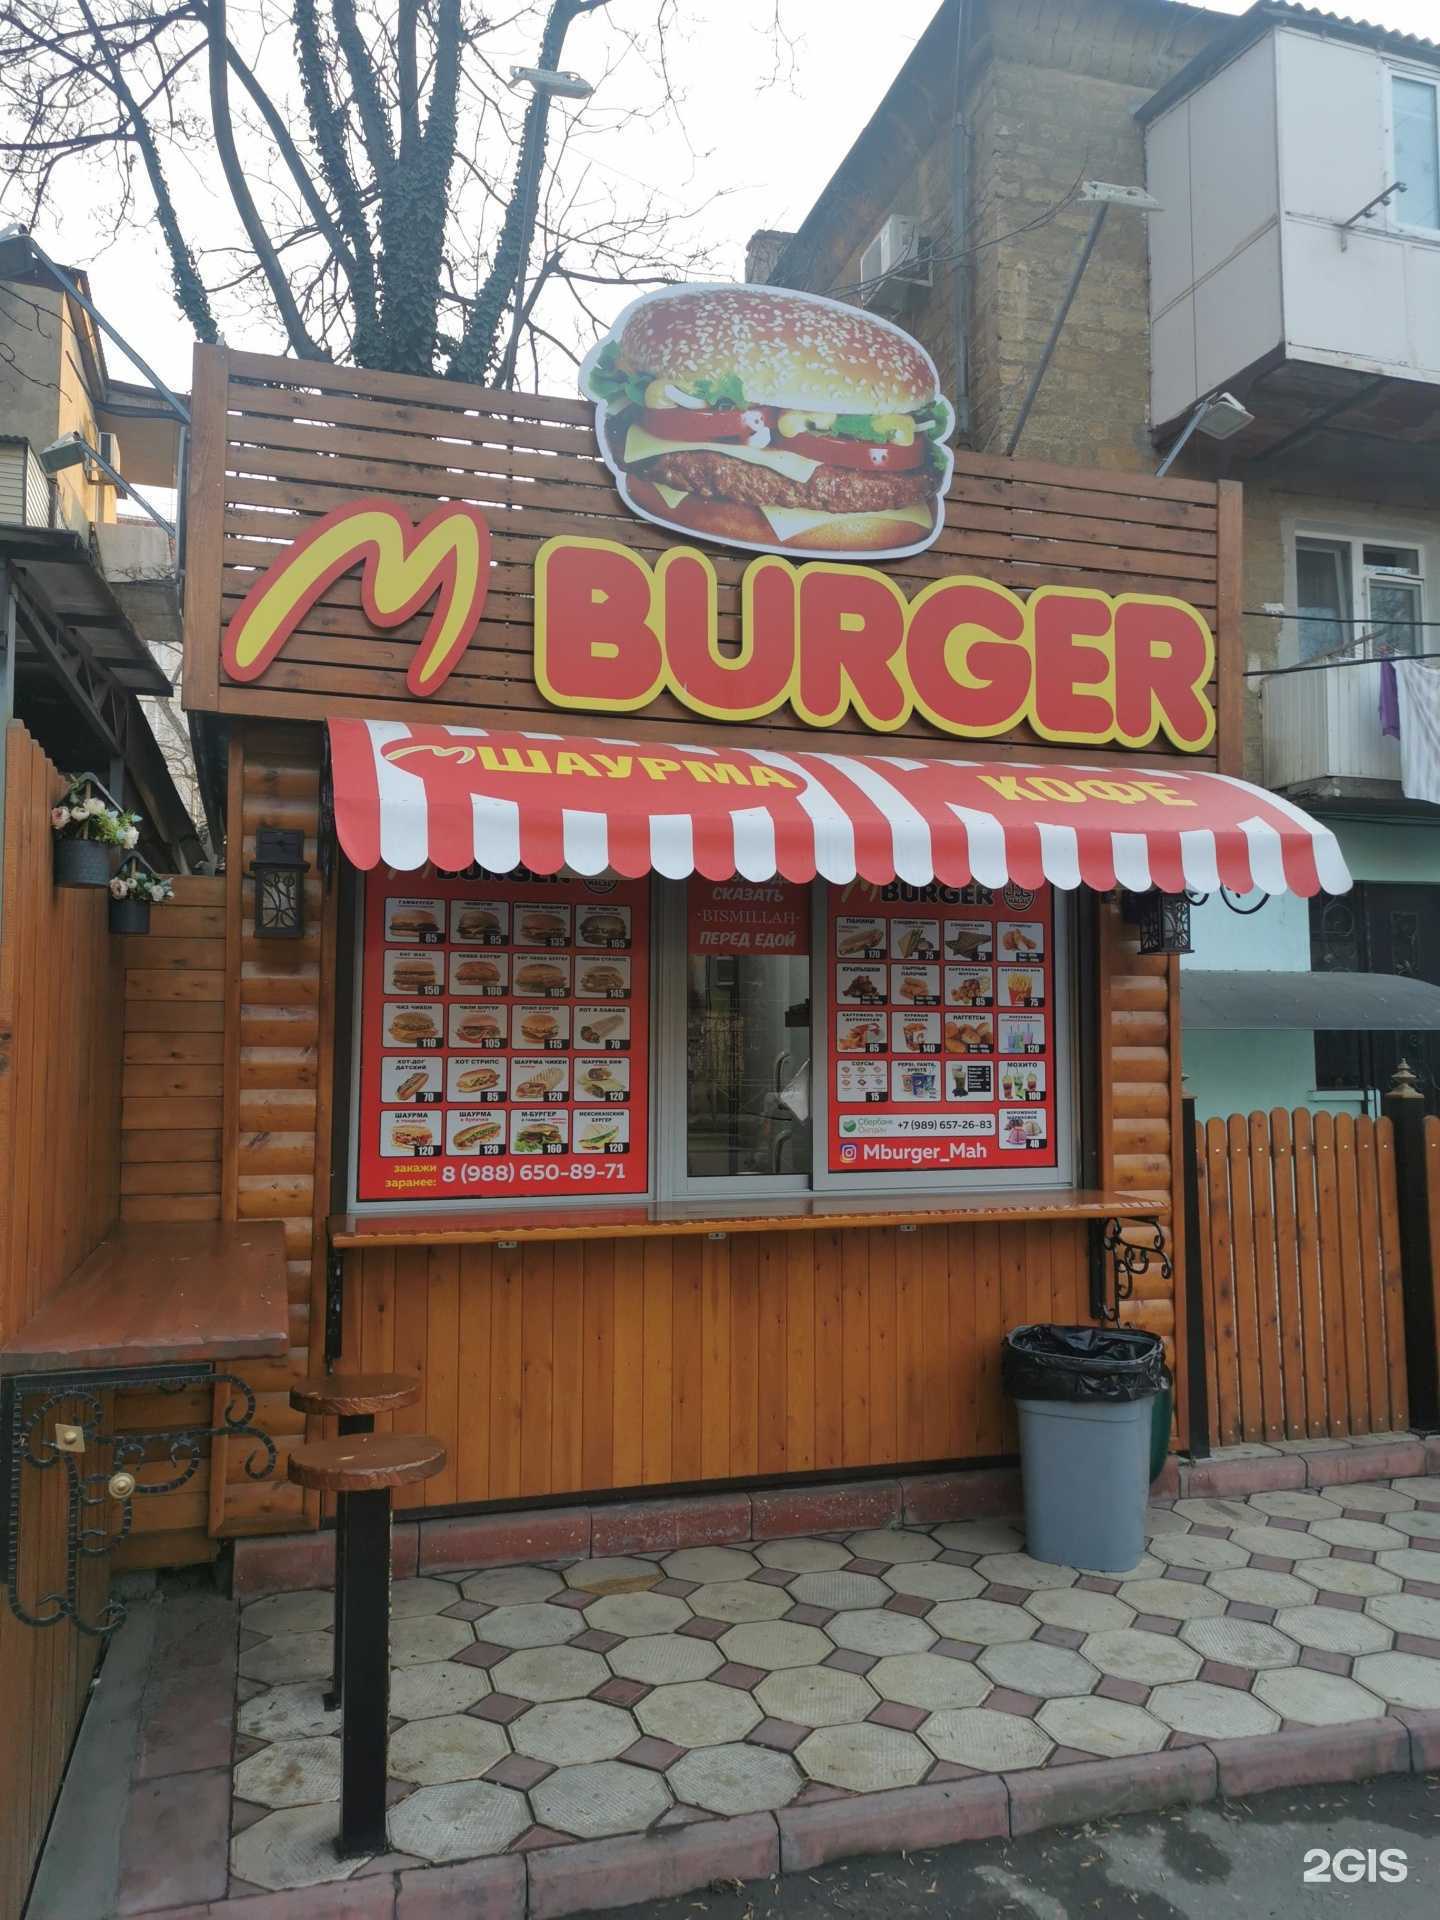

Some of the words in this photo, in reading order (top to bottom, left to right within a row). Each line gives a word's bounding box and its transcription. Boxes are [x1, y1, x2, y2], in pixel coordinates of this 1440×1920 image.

[534, 535, 1216, 752] BURGER
[476, 746, 797, 789] ШАУРМА
[976, 775, 1199, 805] КОФЕ
[712, 886, 784, 903] СКАЗАТЬ
[880, 881, 993, 905] BURGER
[699, 931, 752, 948] ПЕРЕД
[755, 929, 797, 948] ЕДОЙ
[422, 1039, 437, 1048] 110
[485, 1039, 501, 1048] 105
[611, 1040, 621, 1049] 70
[1027, 1045, 1040, 1053] 120
[423, 1092, 435, 1102] 70
[486, 1092, 499, 1102] 85
[547, 1092, 562, 1101] 120
[609, 1092, 624, 1101] 120
[1028, 1092, 1041, 1101] 100
[857, 1118, 893, 1127] Сбербанк
[897, 1121, 909, 1130] +7
[911, 1120, 938, 1130] (989)
[939, 1120, 993, 1130] 657-26-83
[545, 1144, 562, 1153] 160
[608, 1143, 624, 1153] 120
[1029, 1140, 1040, 1148] 40
[417, 1146, 435, 1156] 120
[483, 1145, 499, 1154] 120
[863, 1142, 988, 1164] Mburger_Mah
[393, 1164, 437, 1173] закажи
[442, 1166, 456, 1182] 8
[460, 1163, 516, 1184] (988)
[519, 1163, 626, 1181] 650-89-71
[384, 1178, 438, 1189] заранее:
